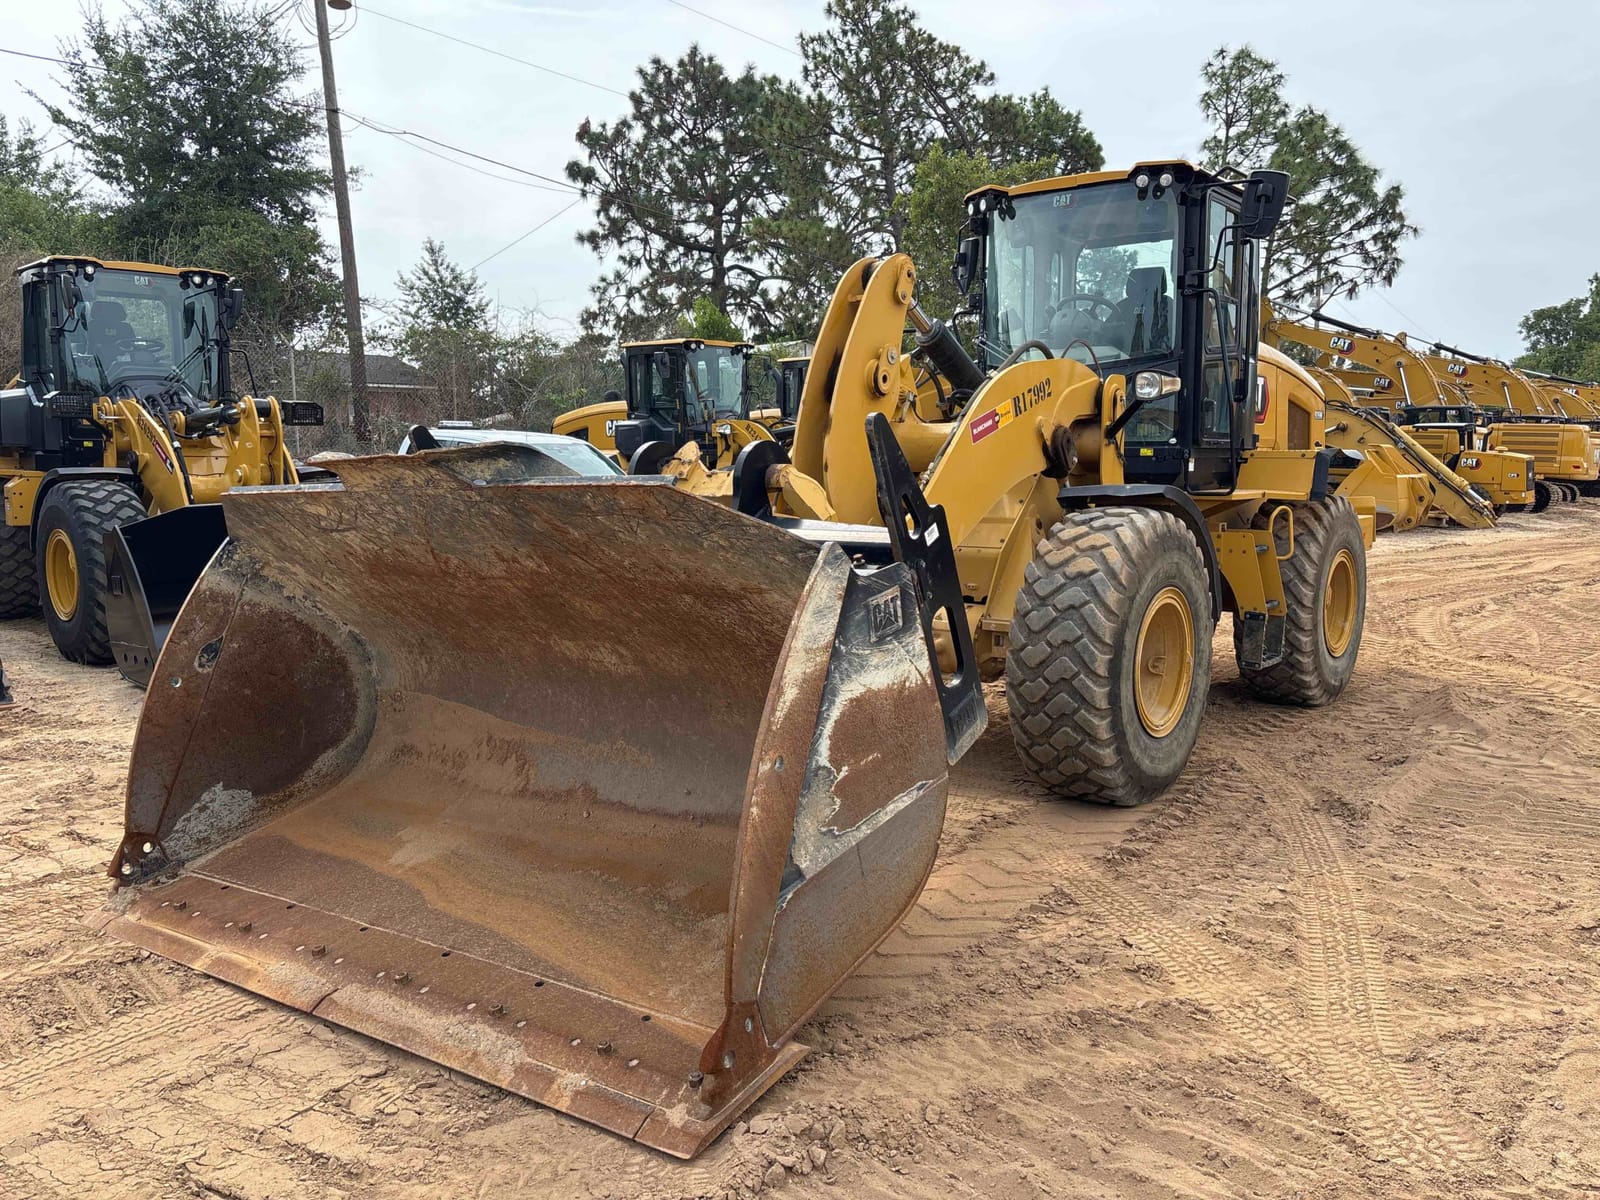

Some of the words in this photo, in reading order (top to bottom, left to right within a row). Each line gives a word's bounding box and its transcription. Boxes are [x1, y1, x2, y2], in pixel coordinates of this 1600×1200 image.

[1053, 193, 1072, 207] CAT
[134, 275, 149, 285] CAT
[1329, 336, 1352, 351] CAT
[1447, 363, 1465, 375] CAT
[1373, 377, 1391, 388] CAT
[1013, 377, 1052, 417] R17992
[1461, 458, 1478, 467] CAT
[873, 594, 899, 634] CAT
